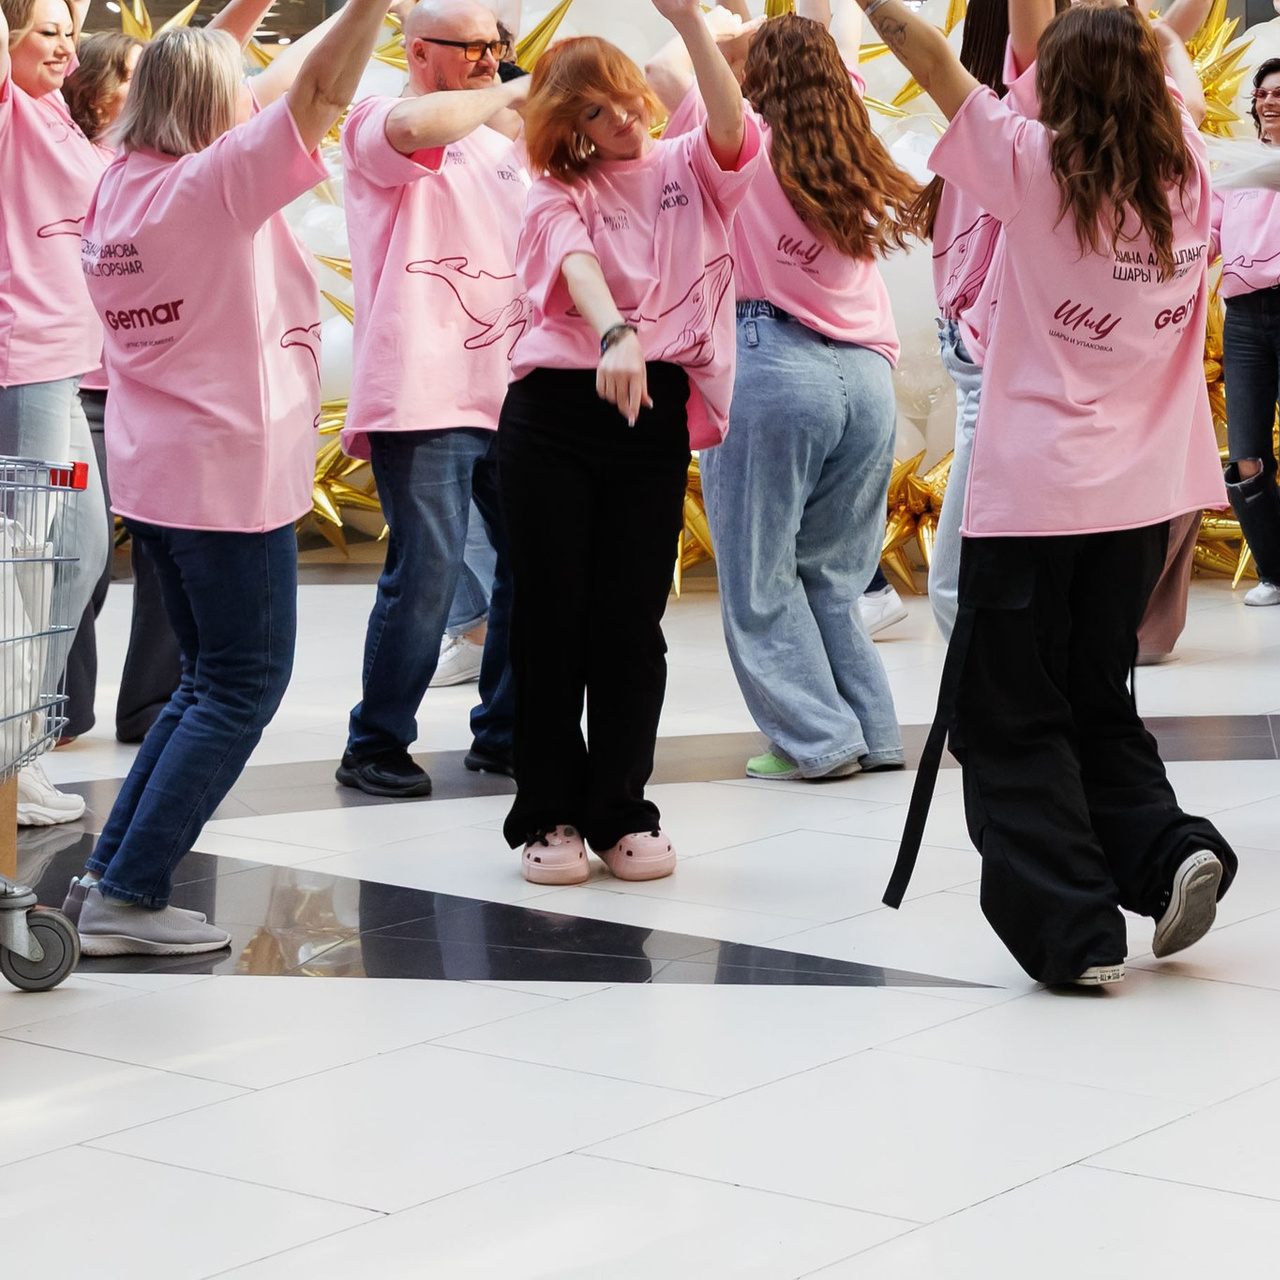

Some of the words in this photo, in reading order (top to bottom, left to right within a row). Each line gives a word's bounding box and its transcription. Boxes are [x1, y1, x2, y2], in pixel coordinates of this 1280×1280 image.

[1113, 266, 1151, 283] ШАРЫ
[105, 299, 184, 331] Gemar
[1049, 329, 1070, 342] ШАРЫ
[1077, 339, 1113, 352] УПАКОВКА
